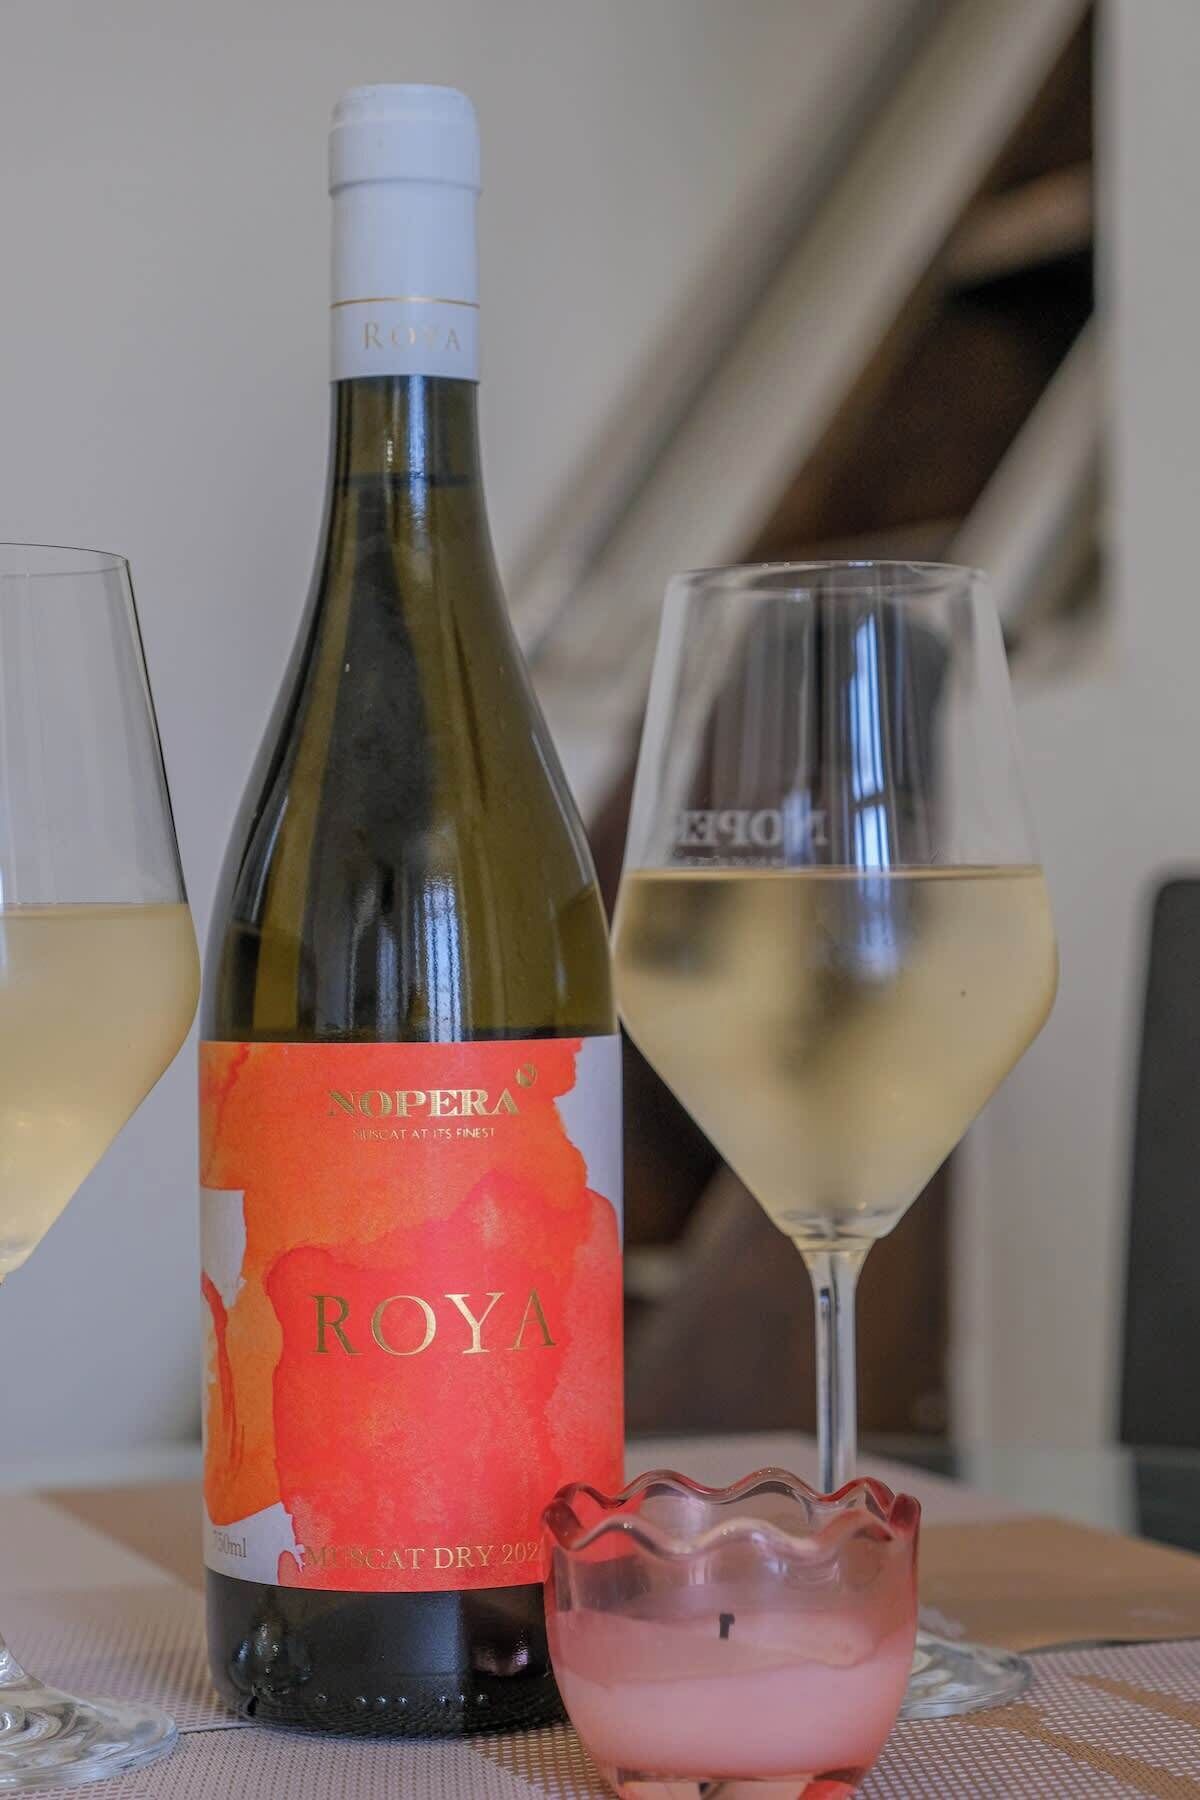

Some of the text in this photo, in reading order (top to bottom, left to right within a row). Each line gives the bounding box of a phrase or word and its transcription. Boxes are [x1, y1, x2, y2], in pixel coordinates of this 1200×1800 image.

[363, 321, 461, 351] ROYA
[327, 1087, 521, 1118] NOPERA
[352, 1127, 495, 1140] MUSCAT AT ITS FINEST
[309, 1287, 557, 1356] ROYA
[303, 1542, 540, 1570] MUSCAT DRY 202
